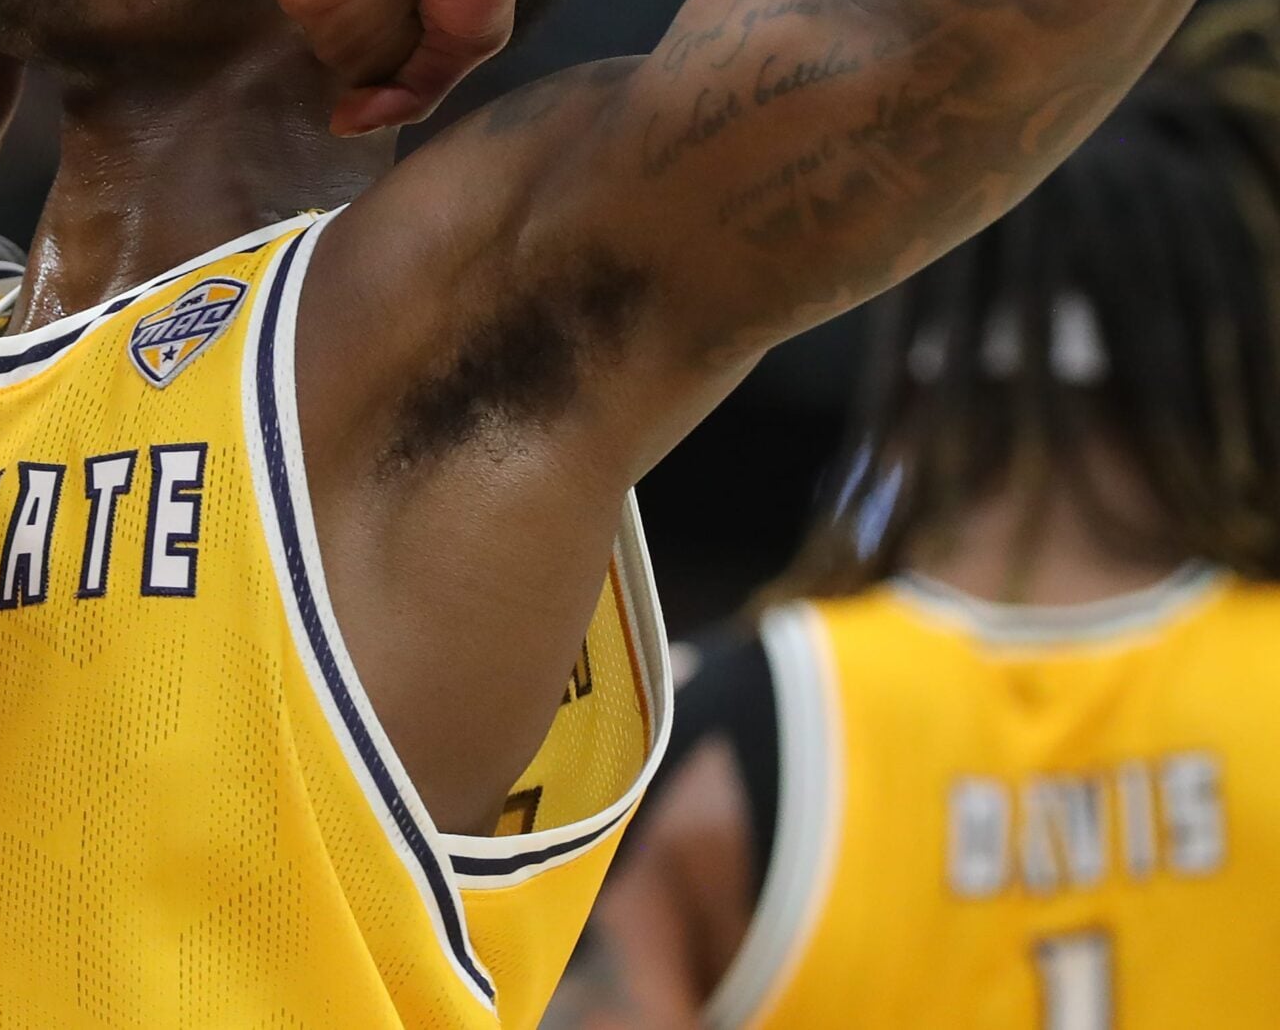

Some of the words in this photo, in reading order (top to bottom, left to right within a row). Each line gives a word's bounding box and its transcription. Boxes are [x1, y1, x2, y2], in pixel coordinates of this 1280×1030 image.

[130, 303, 232, 347] MAC
[944, 748, 1230, 901] DAVIS
[1028, 922, 1118, 1030] 1
